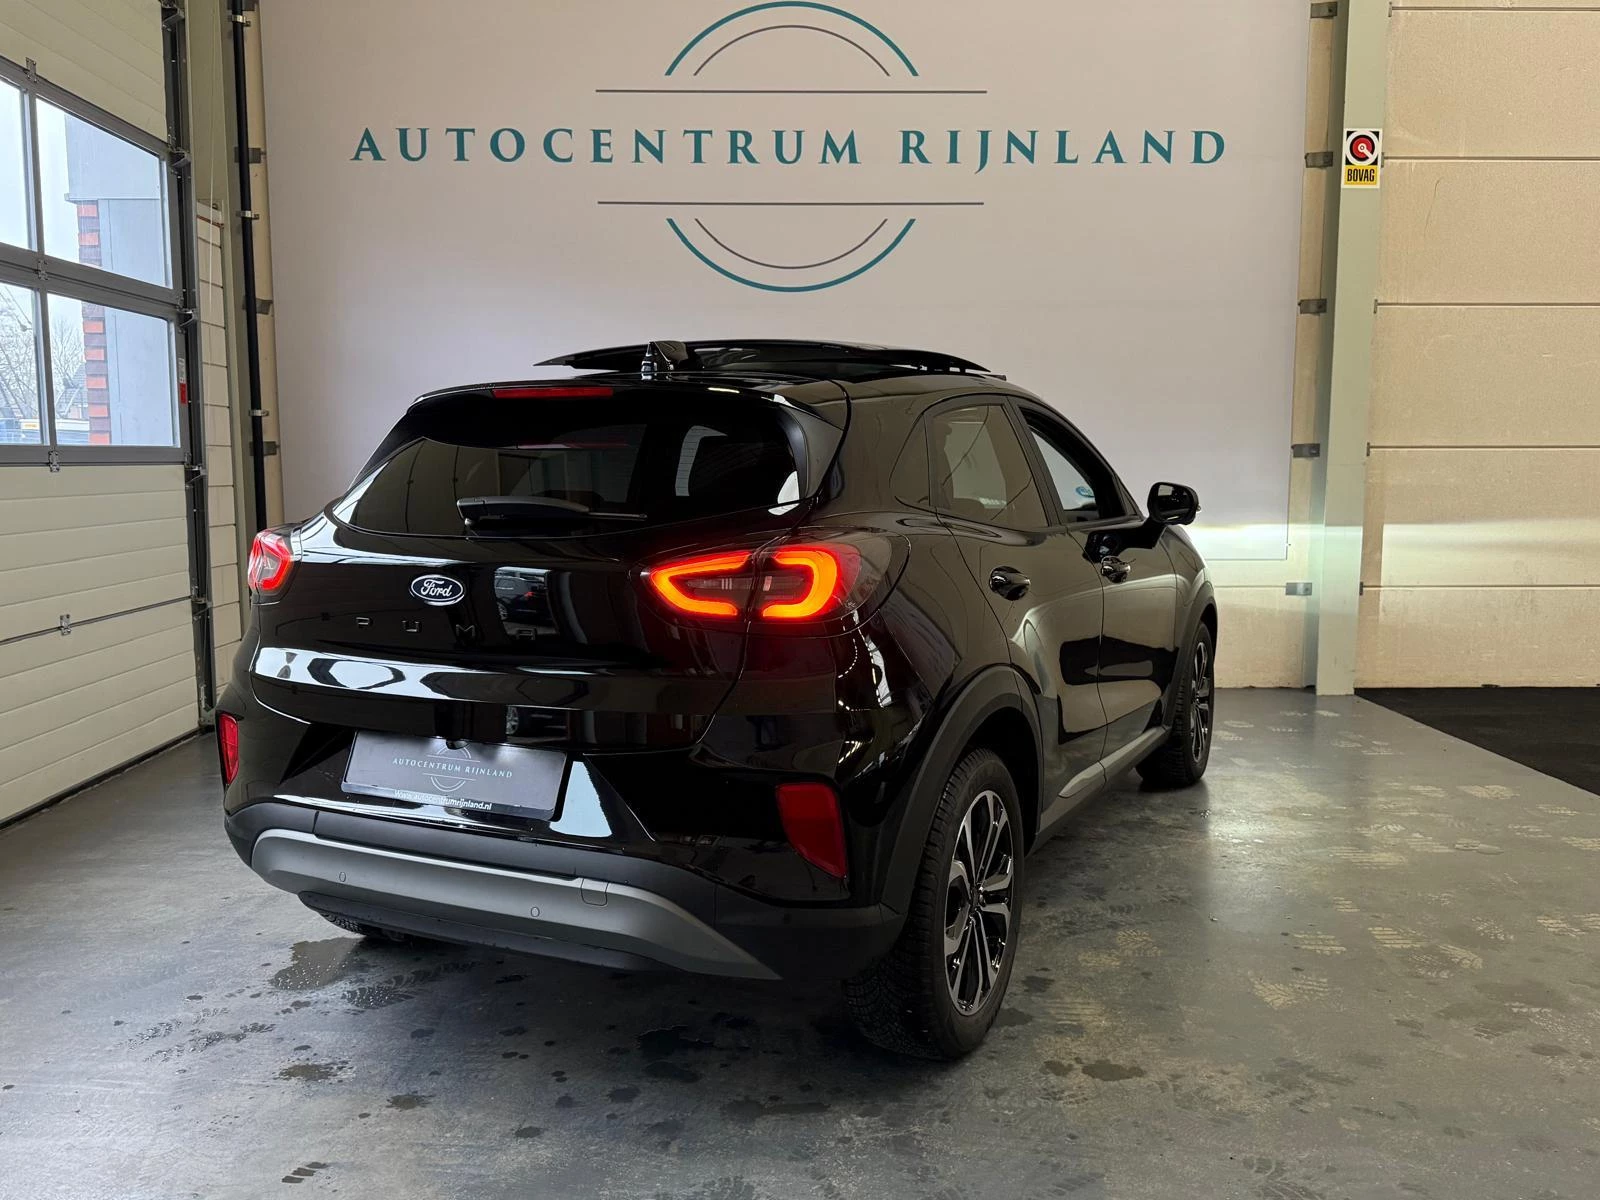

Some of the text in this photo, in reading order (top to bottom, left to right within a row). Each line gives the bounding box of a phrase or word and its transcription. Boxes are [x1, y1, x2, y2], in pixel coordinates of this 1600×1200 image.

[350, 127, 1225, 174] AUTOCENTRUM RIJNLAND
[1347, 168, 1375, 182] BOVAG
[420, 579, 452, 597] Ford
[392, 757, 513, 778] AUTOCENTRUM RIJNLAND
